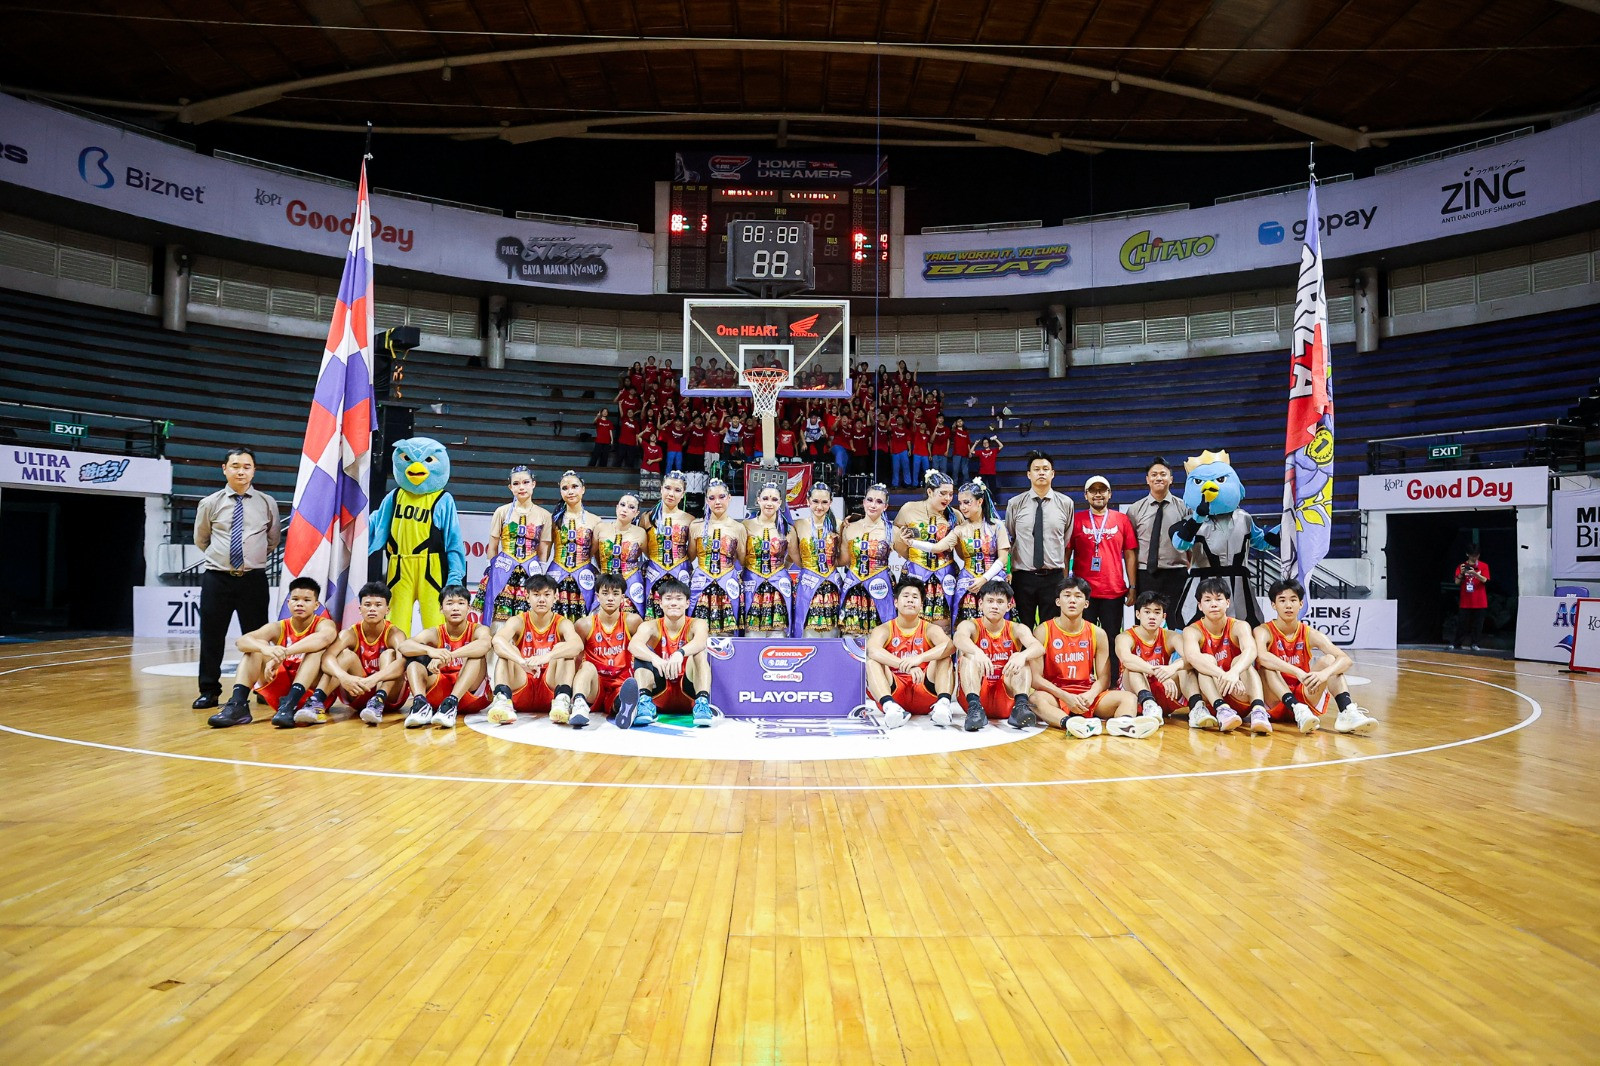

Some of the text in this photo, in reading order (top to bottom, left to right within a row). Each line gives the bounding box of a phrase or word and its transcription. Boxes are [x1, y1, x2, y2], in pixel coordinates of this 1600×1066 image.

[757, 160, 807, 169] HOME
[757, 170, 853, 179] DREAMERS
[125, 166, 204, 204] Biznet
[1441, 200, 1527, 224] ANTI DANDRUFF SHAMPOO
[501, 245, 519, 256] PAKE
[925, 253, 955, 262] YANG
[958, 250, 998, 261] WORTH
[1018, 247, 1033, 257] YA
[1035, 245, 1068, 255] CUMA
[522, 264, 541, 275] GAYA
[543, 264, 568, 275] MAKIN
[716, 324, 739, 336] One
[55, 424, 85, 436] EXIT
[1432, 446, 1459, 457] EXIT
[14, 450, 71, 469] ULTRA
[22, 467, 67, 483] MILK
[1406, 478, 1462, 500] Good
[1467, 476, 1513, 502] Day
[739, 691, 834, 703] PLAYOFFS
